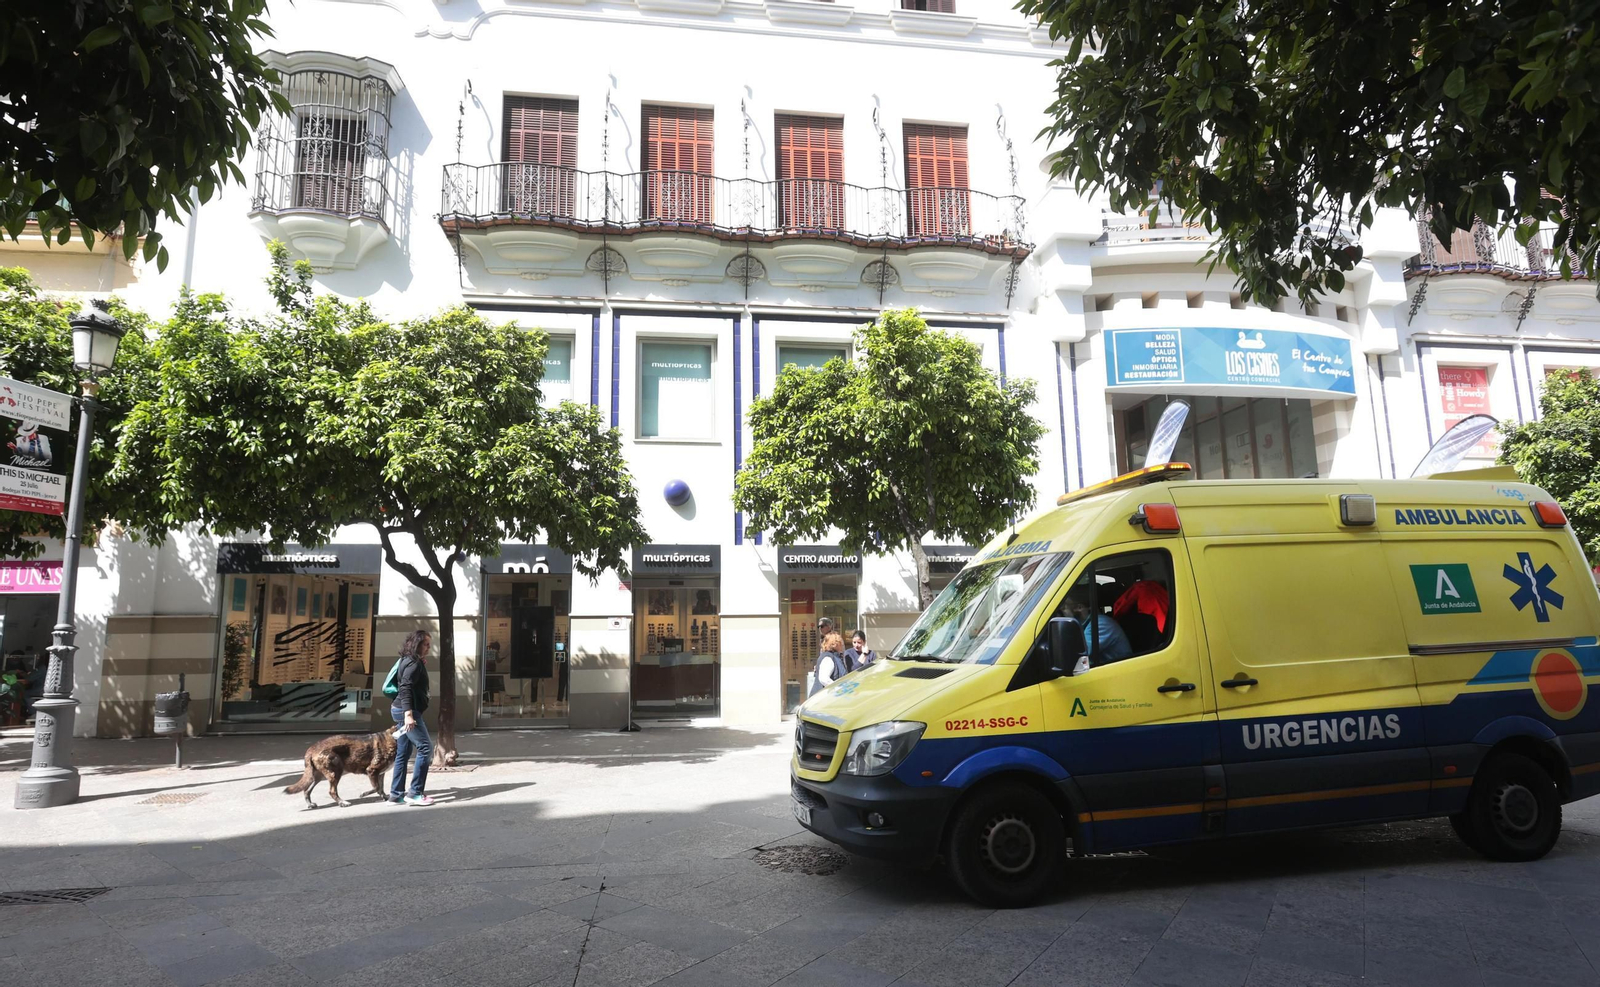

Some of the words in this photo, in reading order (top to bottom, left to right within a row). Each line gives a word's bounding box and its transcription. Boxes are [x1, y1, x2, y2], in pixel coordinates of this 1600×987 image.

[1151, 355, 1177, 363] ÓPTICA
[1225, 351, 1246, 375] LOS
[1247, 352, 1280, 377] CISNES
[1292, 348, 1300, 360] El
[1304, 350, 1332, 363] Centro
[1334, 355, 1344, 365] de
[1124, 370, 1178, 379] RESTAURACIÓN
[1302, 362, 1316, 373] tus
[1318, 364, 1351, 378] Compras
[1440, 370, 1462, 380] there
[17, 393, 33, 403] TIO
[37, 399, 57, 409] PEPE
[1456, 388, 1486, 399] Howdy
[10, 454, 52, 467] Michael
[0, 467, 17, 478] THIS
[18, 470, 25, 479] IS
[26, 473, 61, 485] MICHAEL
[1395, 509, 1527, 525] AMBULANCIA
[783, 555, 816, 563] CENTRO
[818, 555, 858, 563] AUDITIVO
[16, 562, 63, 586] UÑAS
[945, 716, 1028, 731] 02214-SSG-C
[1242, 714, 1401, 750] URGENCIAS
